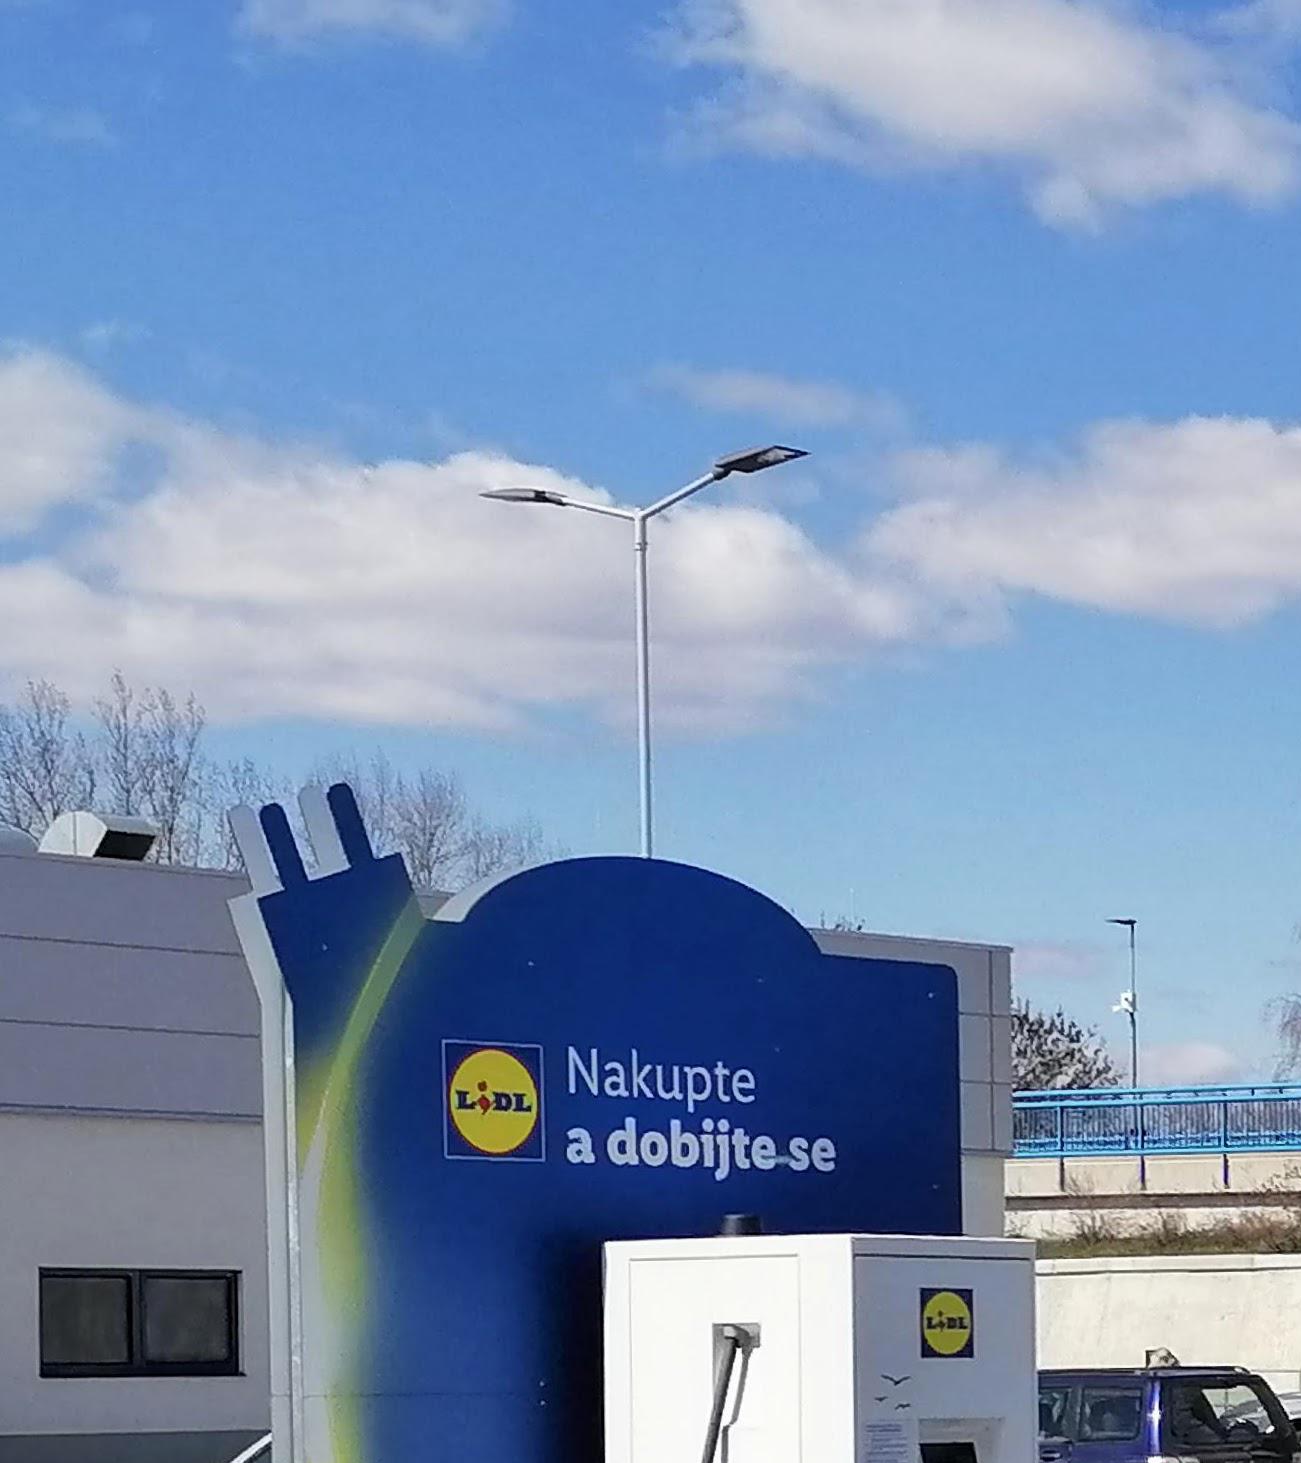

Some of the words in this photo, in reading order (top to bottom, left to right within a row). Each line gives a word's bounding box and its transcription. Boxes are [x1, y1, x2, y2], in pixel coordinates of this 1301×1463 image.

[455, 1081, 532, 1115] LIDL
[567, 1046, 756, 1113] Nakupte
[566, 1127, 596, 1164] a
[606, 1116, 776, 1182] dobijte
[788, 1136, 837, 1172] se
